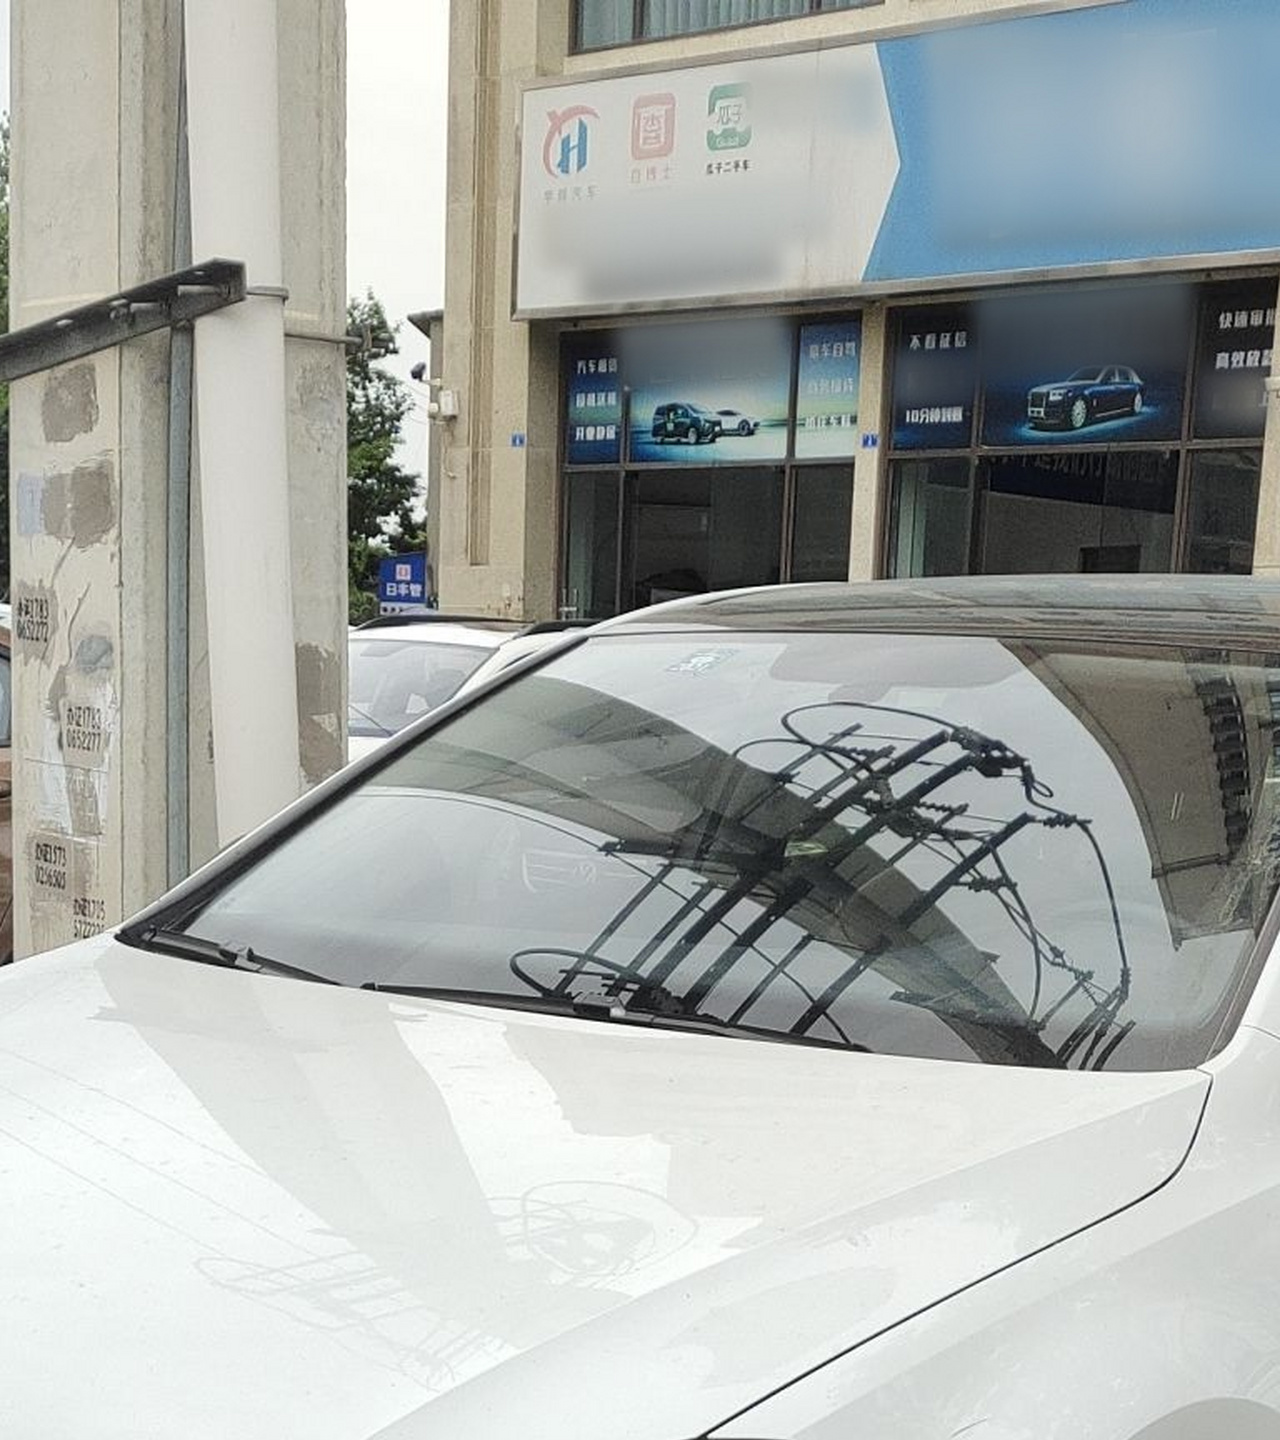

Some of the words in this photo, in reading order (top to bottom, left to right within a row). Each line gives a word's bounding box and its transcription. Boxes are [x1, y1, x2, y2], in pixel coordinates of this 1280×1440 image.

[706, 159, 751, 176] 瓜子二手车
[385, 582, 422, 598] 日丰管
